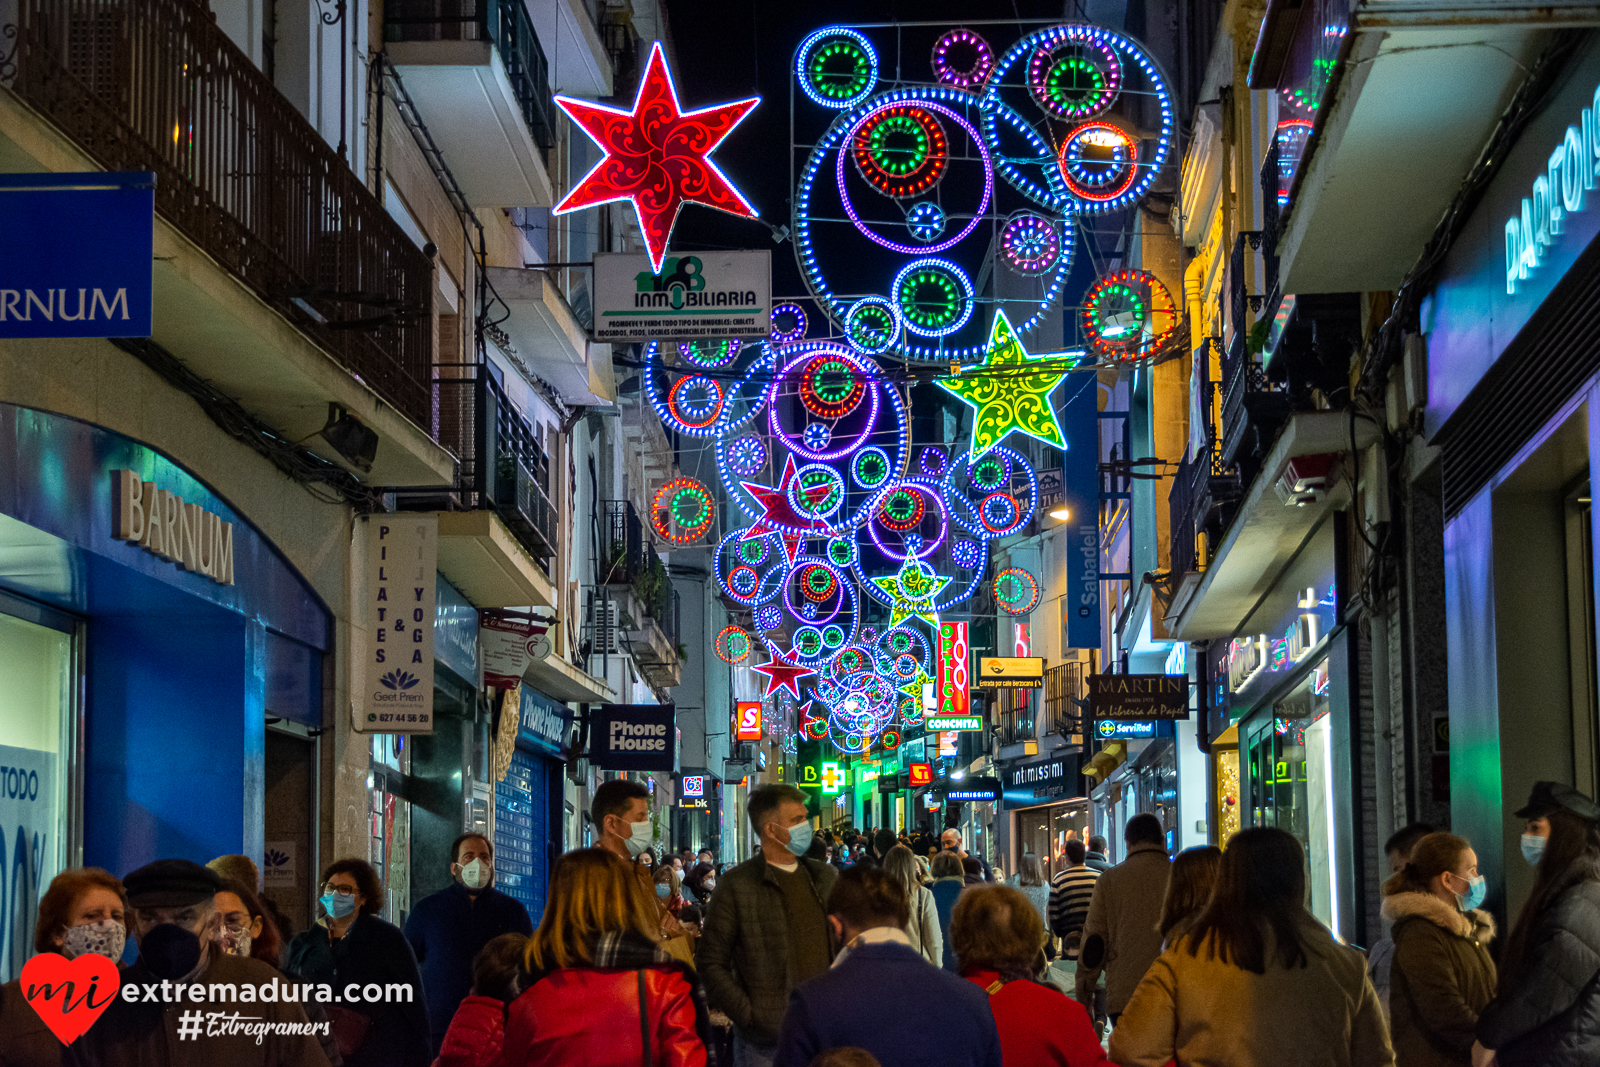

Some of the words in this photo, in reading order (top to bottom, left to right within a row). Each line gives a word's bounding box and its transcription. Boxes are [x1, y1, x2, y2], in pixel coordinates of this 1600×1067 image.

[634, 290, 757, 310] INMOBILIARIA
[608, 320, 639, 328] PROMUEVE
[732, 318, 755, 326] CHALETS
[648, 328, 670, 336] LOCALES
[670, 328, 706, 336] COMERCIALES
[1040, 482, 1060, 490] CASA
[111, 469, 235, 586] BARNUM
[1079, 524, 1098, 606] Sabadell
[375, 525, 390, 664] PILATES
[394, 619, 406, 632] &
[411, 587, 425, 664] YOGA
[939, 624, 956, 713] OPTICA
[374, 691, 398, 702] Geet
[400, 692, 424, 702] Prem
[380, 714, 394, 722] 627
[396, 714, 406, 722] 44
[408, 714, 418, 722] 56
[420, 714, 429, 722] 20
[522, 693, 546, 734] Phone
[543, 704, 564, 743] House
[1096, 705, 1106, 717] La
[1146, 704, 1157, 716] de
[1160, 704, 1185, 718] Papel
[610, 720, 666, 736] Phone
[928, 718, 980, 729] CONCHITA
[1116, 722, 1152, 733] ServiRed
[609, 736, 666, 750] House
[1012, 762, 1063, 786] intimissimi
[0, 766, 38, 801] TODO
